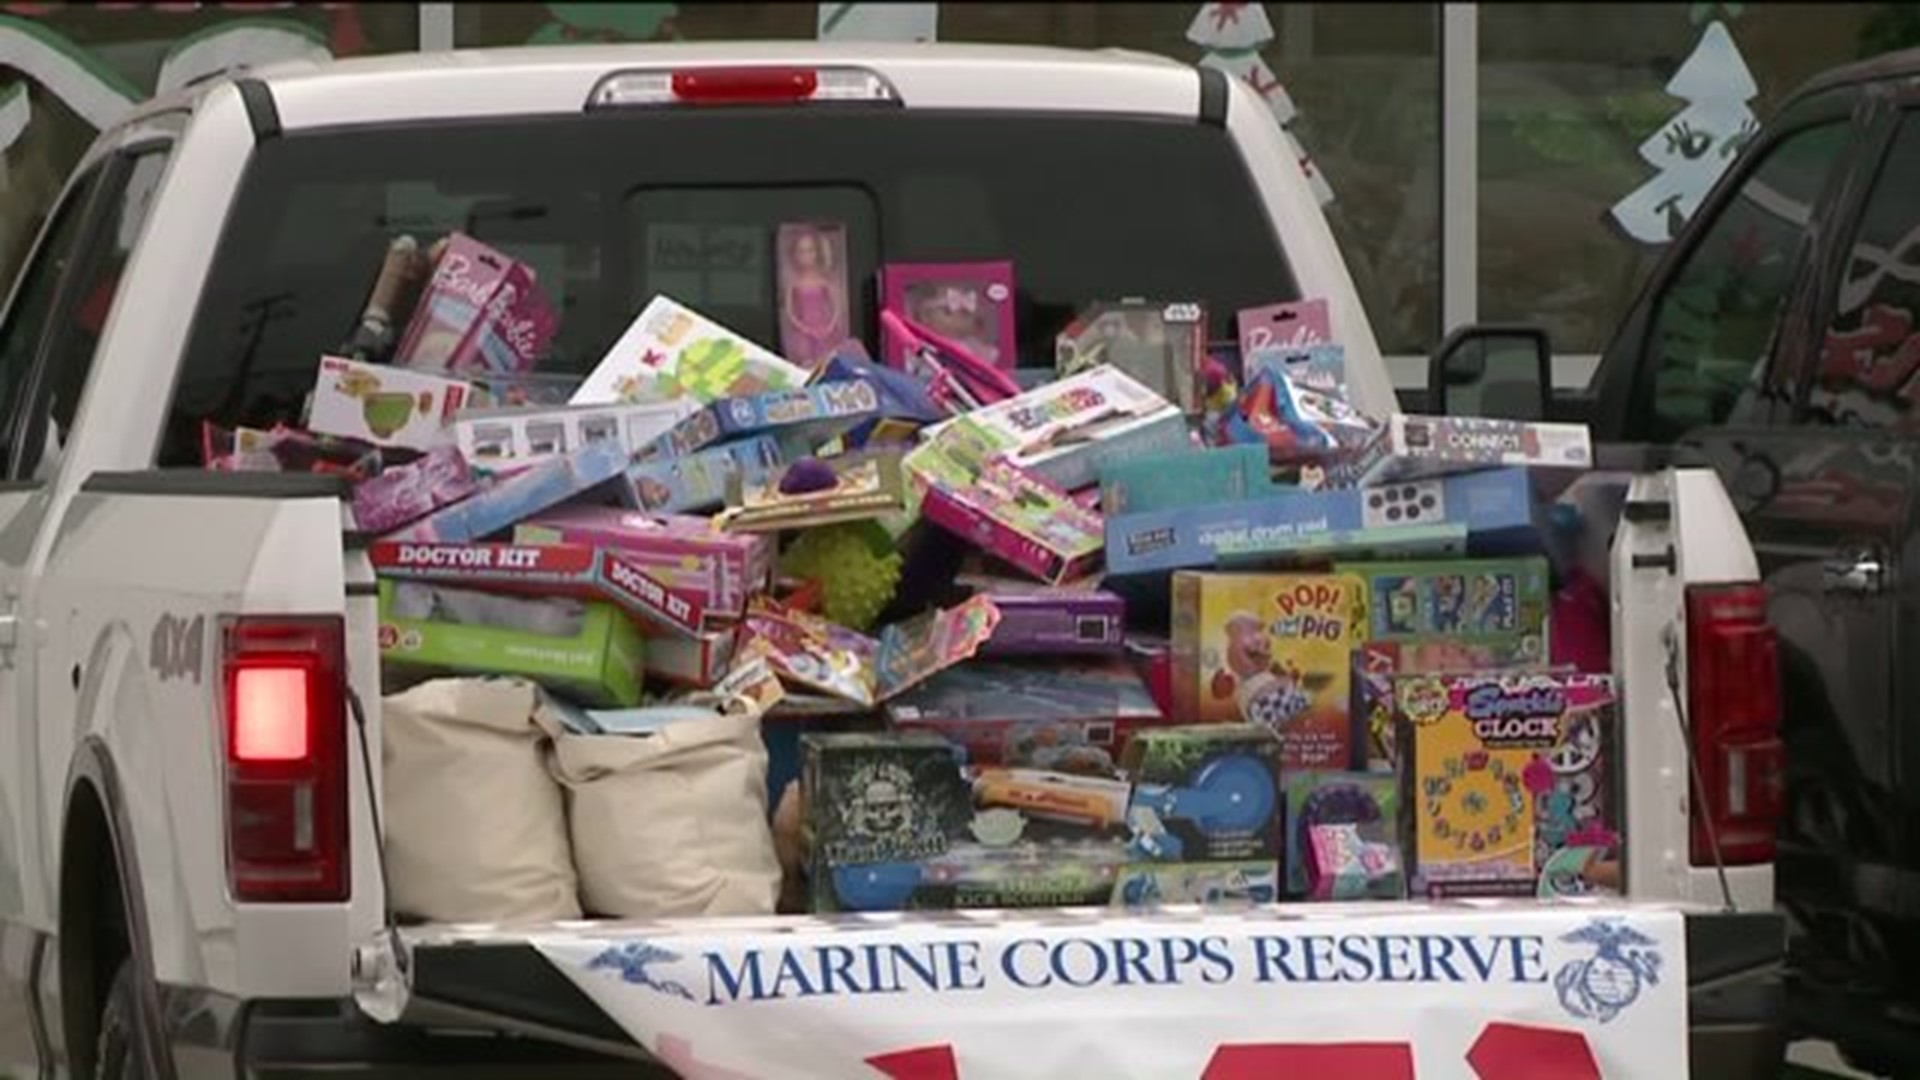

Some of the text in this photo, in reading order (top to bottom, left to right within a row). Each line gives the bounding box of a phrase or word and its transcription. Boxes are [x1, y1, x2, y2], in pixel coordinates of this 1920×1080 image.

[398, 545, 541, 568] DOCTOR KIT
[610, 561, 691, 621] DOCTOR KIT
[1276, 583, 1340, 616] POP!
[1475, 718, 1559, 738] CLOCK
[702, 934, 1550, 1005] MARINE CORPS RESERVE
